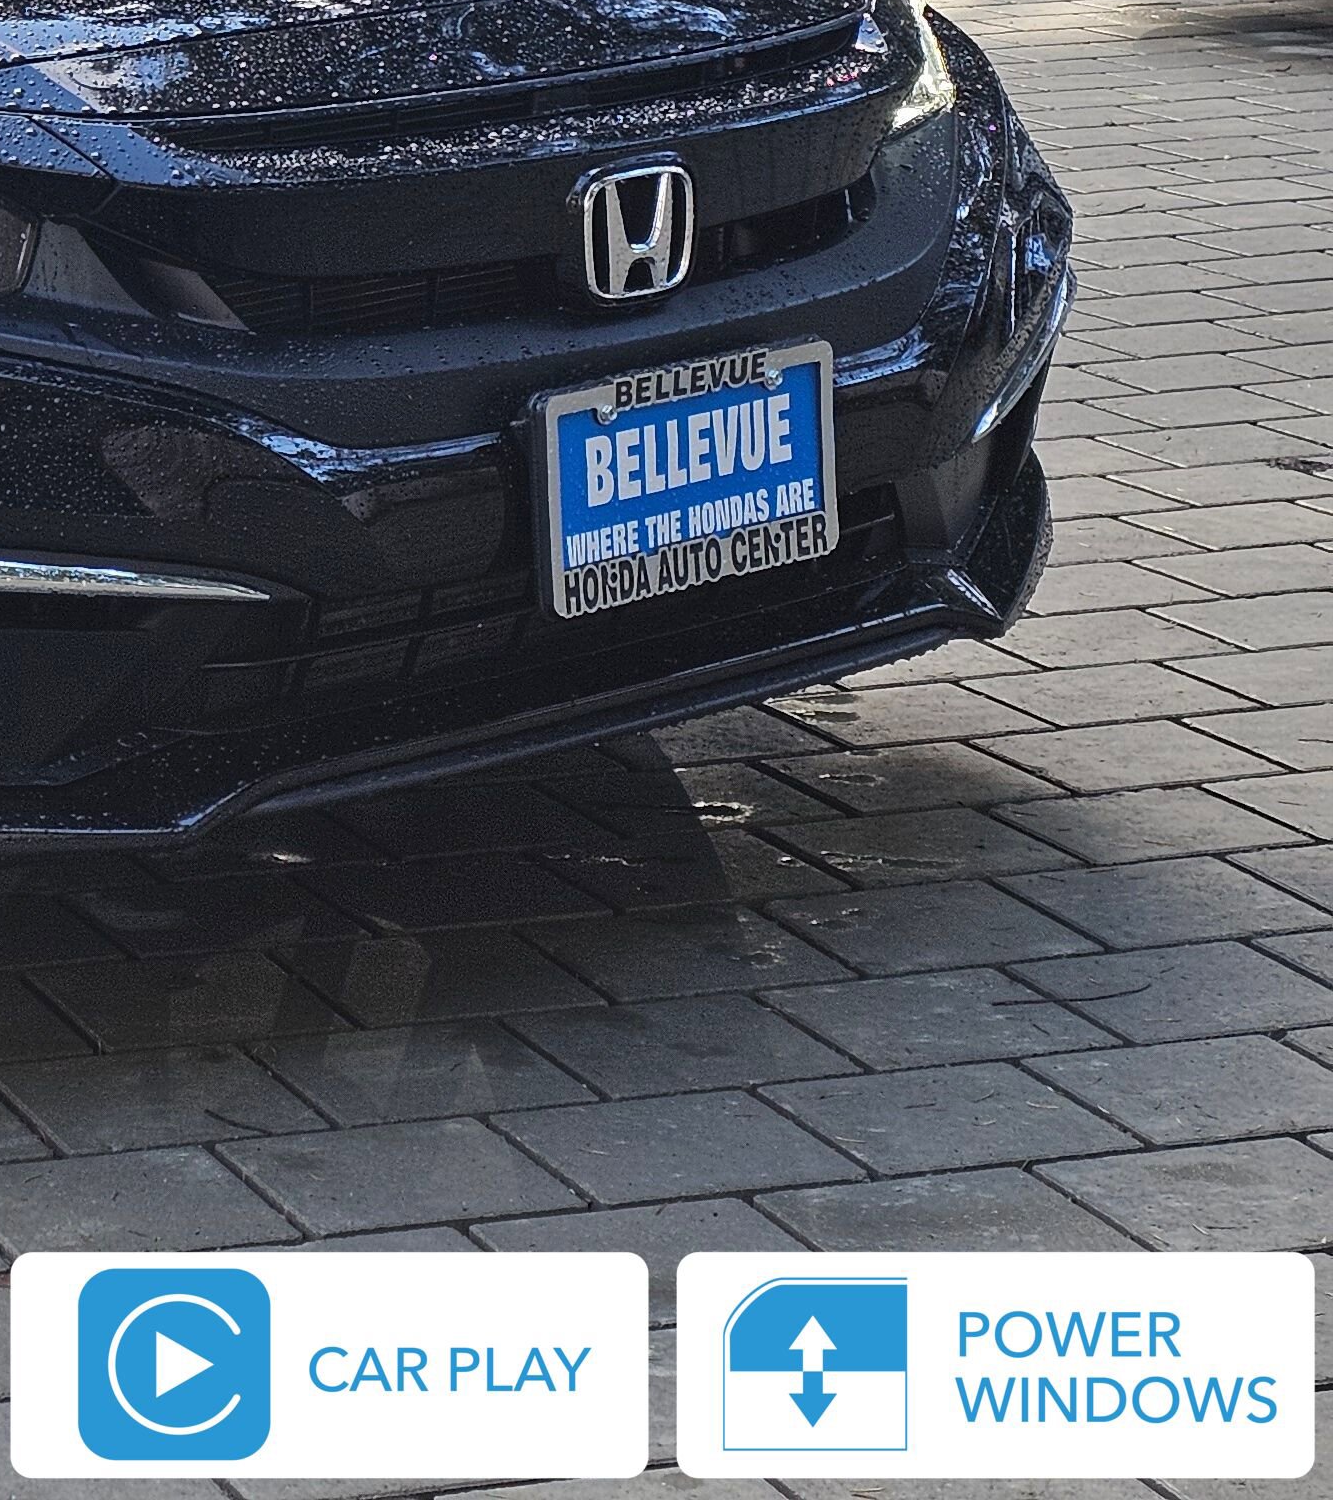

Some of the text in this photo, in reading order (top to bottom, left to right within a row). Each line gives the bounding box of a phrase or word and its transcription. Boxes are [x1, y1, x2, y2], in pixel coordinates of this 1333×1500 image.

[615, 351, 767, 409] BELLEVUE
[585, 393, 793, 508] BELLEVUE
[564, 513, 828, 615] HONDA AUTO CENTER
[566, 478, 816, 568] WHERE THE HONDAS ARE
